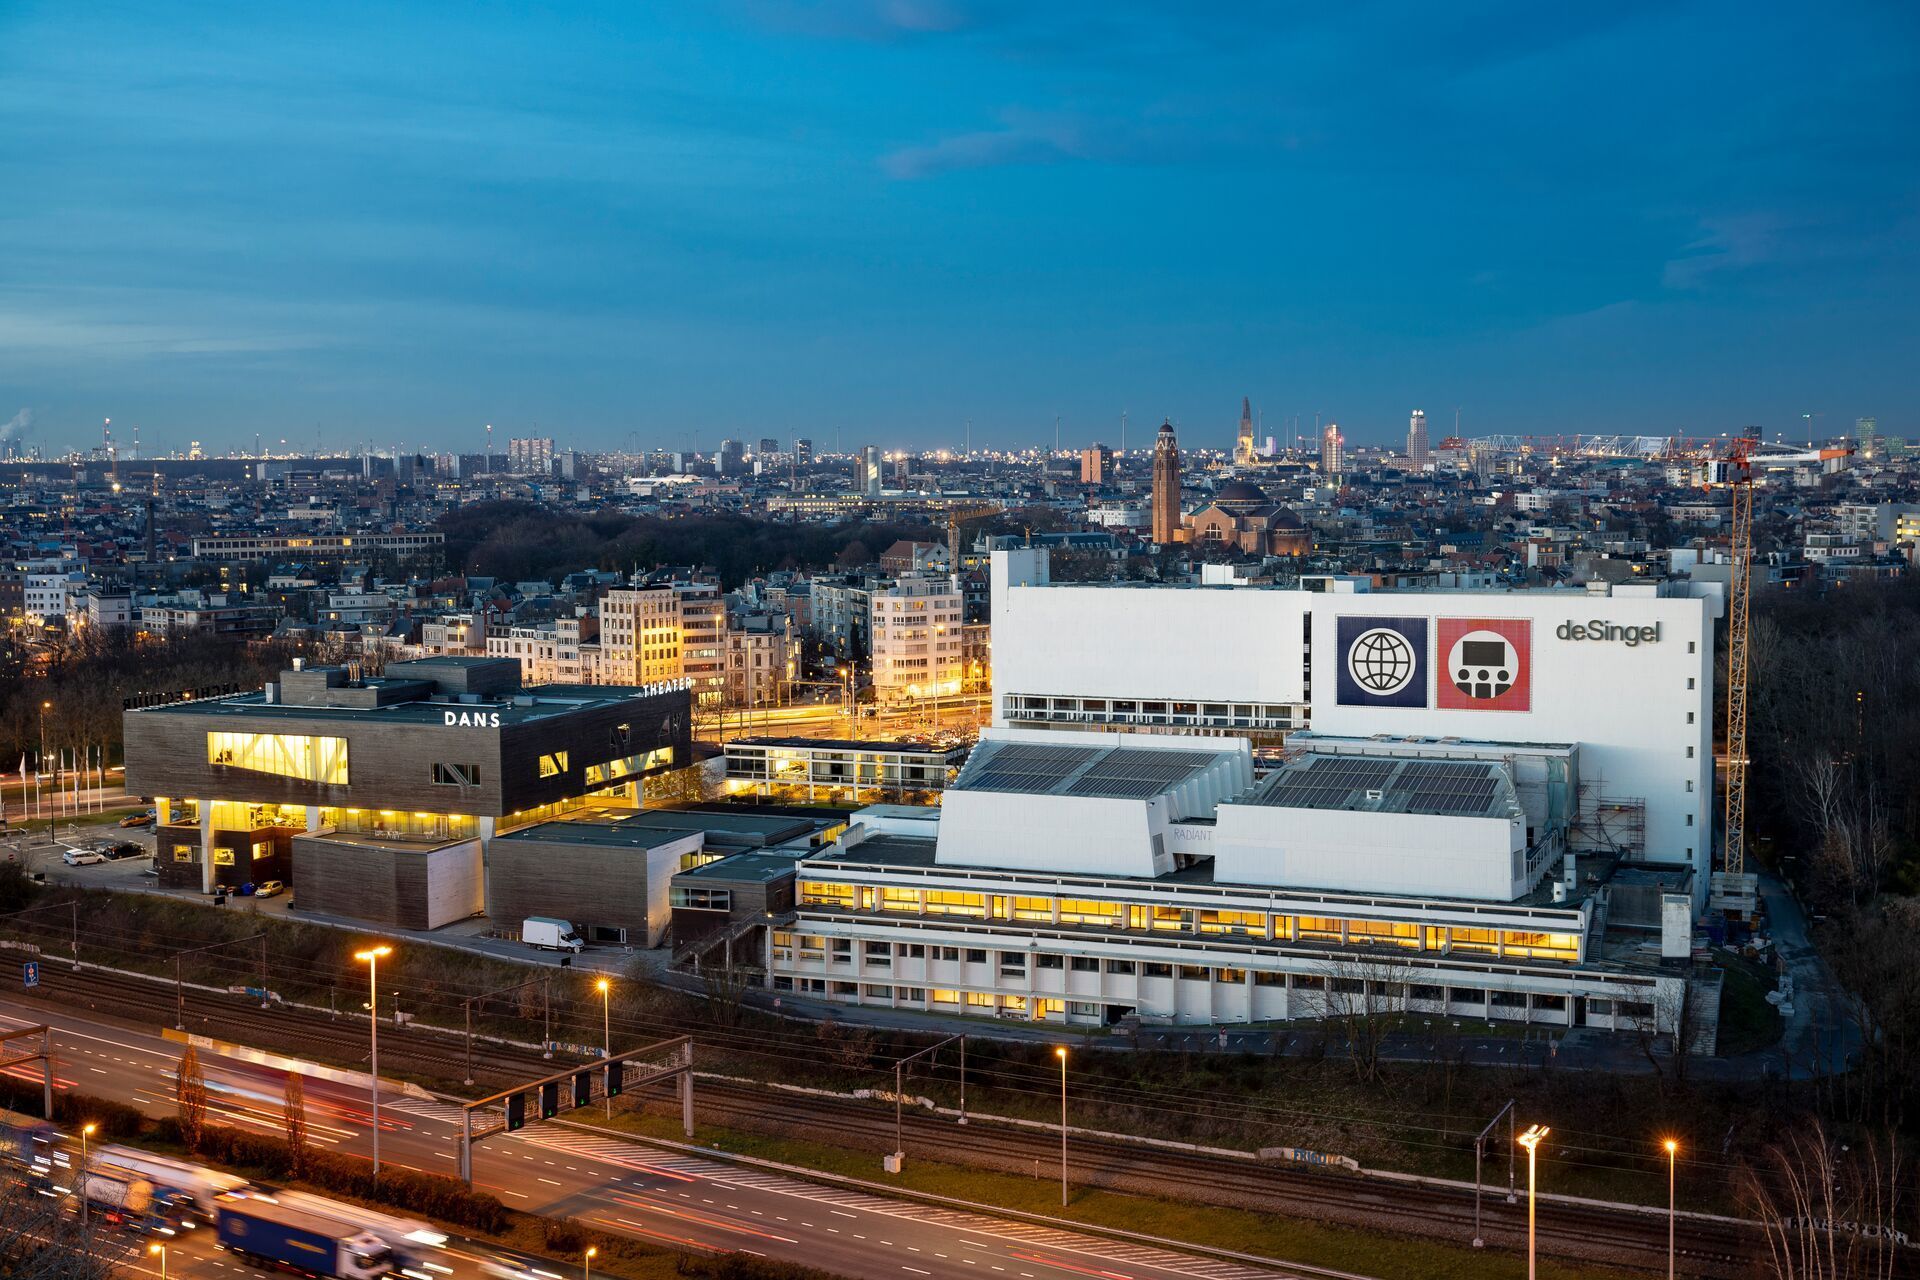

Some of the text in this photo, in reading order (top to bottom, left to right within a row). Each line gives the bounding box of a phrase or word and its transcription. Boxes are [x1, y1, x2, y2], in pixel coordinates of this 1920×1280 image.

[1556, 619, 1661, 647] deSingel
[643, 677, 692, 698] THEATER
[445, 711, 500, 728] DANS
[1174, 828, 1212, 841] RADIANT
